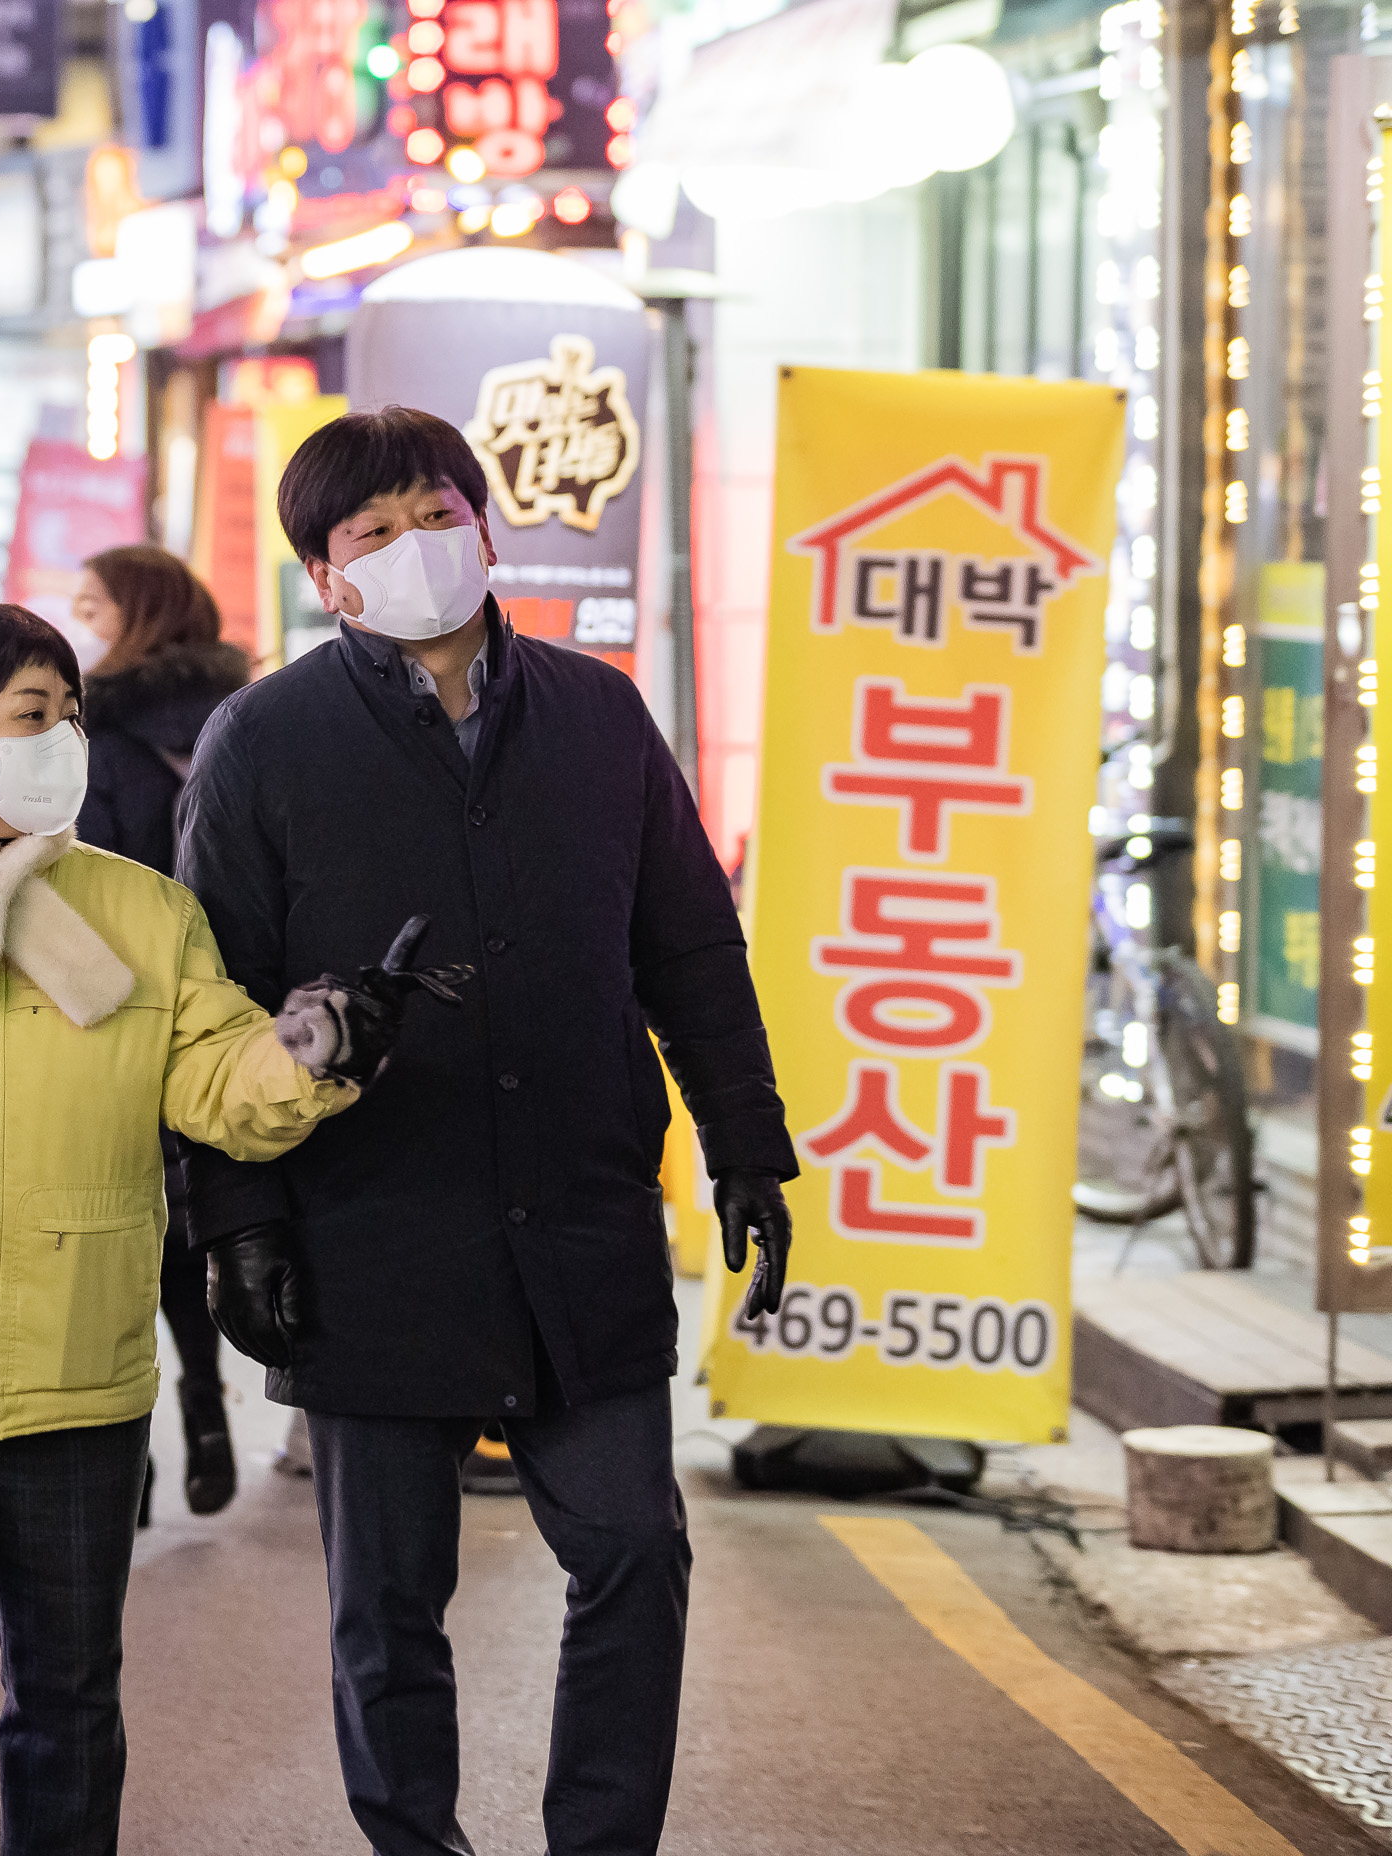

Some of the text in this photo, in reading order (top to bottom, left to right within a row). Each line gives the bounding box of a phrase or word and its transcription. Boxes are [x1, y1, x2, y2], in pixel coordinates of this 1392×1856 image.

[854, 554, 1055, 648] 대박
[808, 682, 1026, 1239] 부동산
[733, 1290, 1051, 1368] 469-5500
